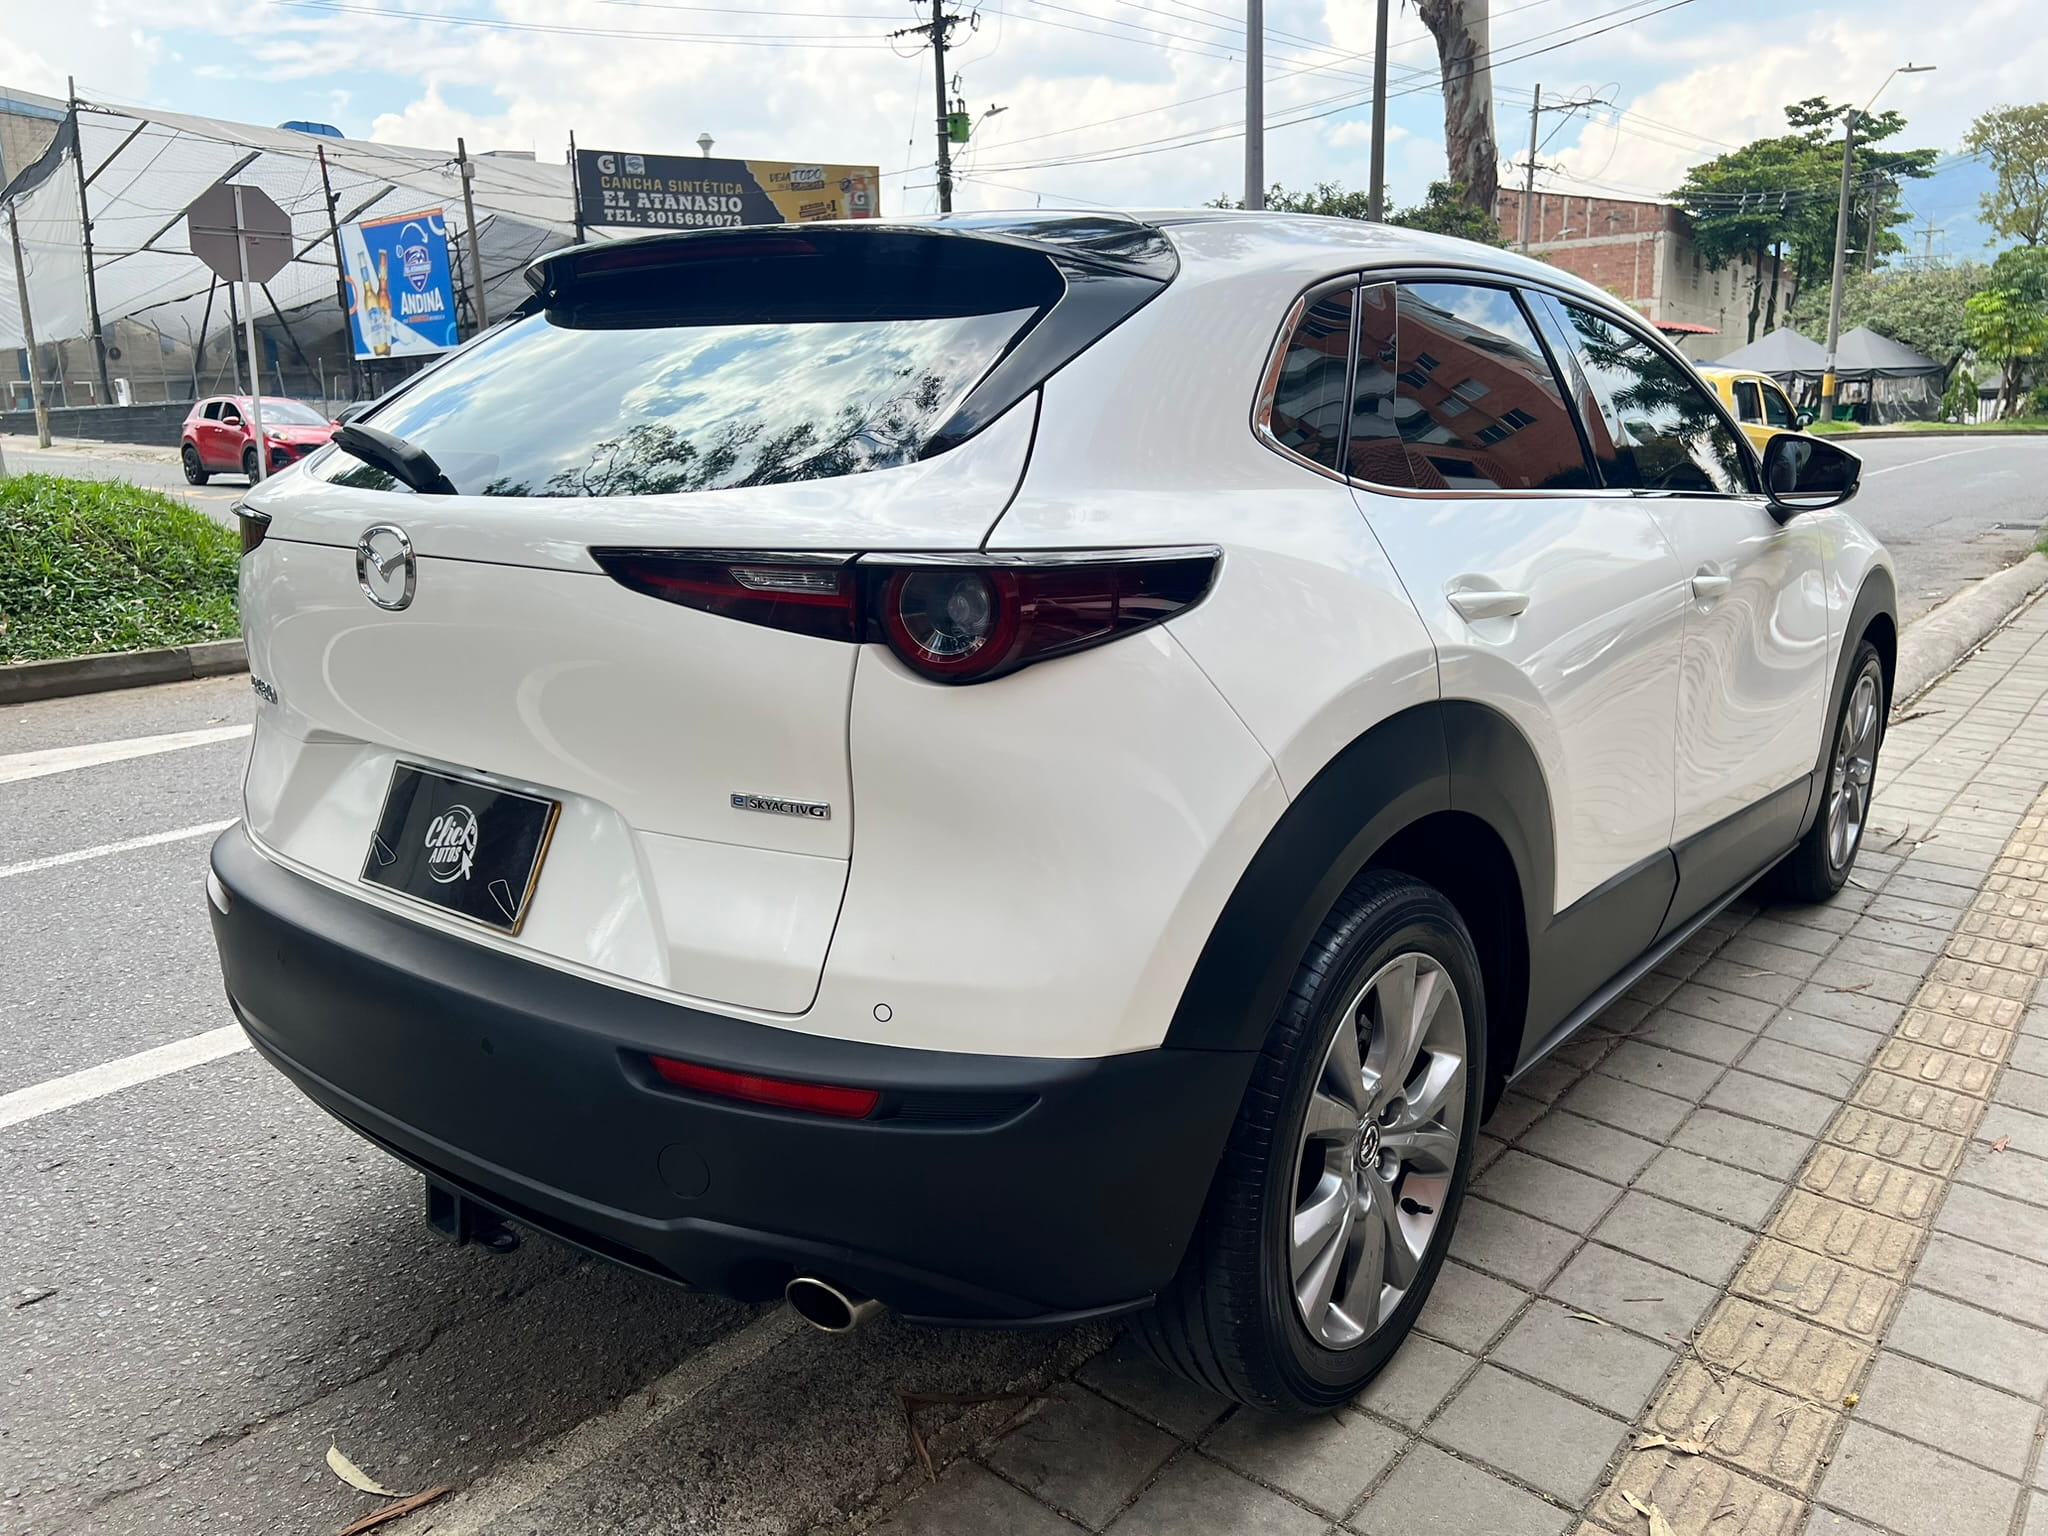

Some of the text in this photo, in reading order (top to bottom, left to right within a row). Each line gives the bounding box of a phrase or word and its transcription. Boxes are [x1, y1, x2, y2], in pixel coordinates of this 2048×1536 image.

[597, 155, 616, 174] G
[791, 168, 822, 181] TODO
[600, 176, 743, 194] CANCHA SINTÉTICA
[603, 191, 743, 213] EL ATANASIO
[603, 209, 742, 226] TEL: 3015684073
[401, 287, 444, 315] ANDINA
